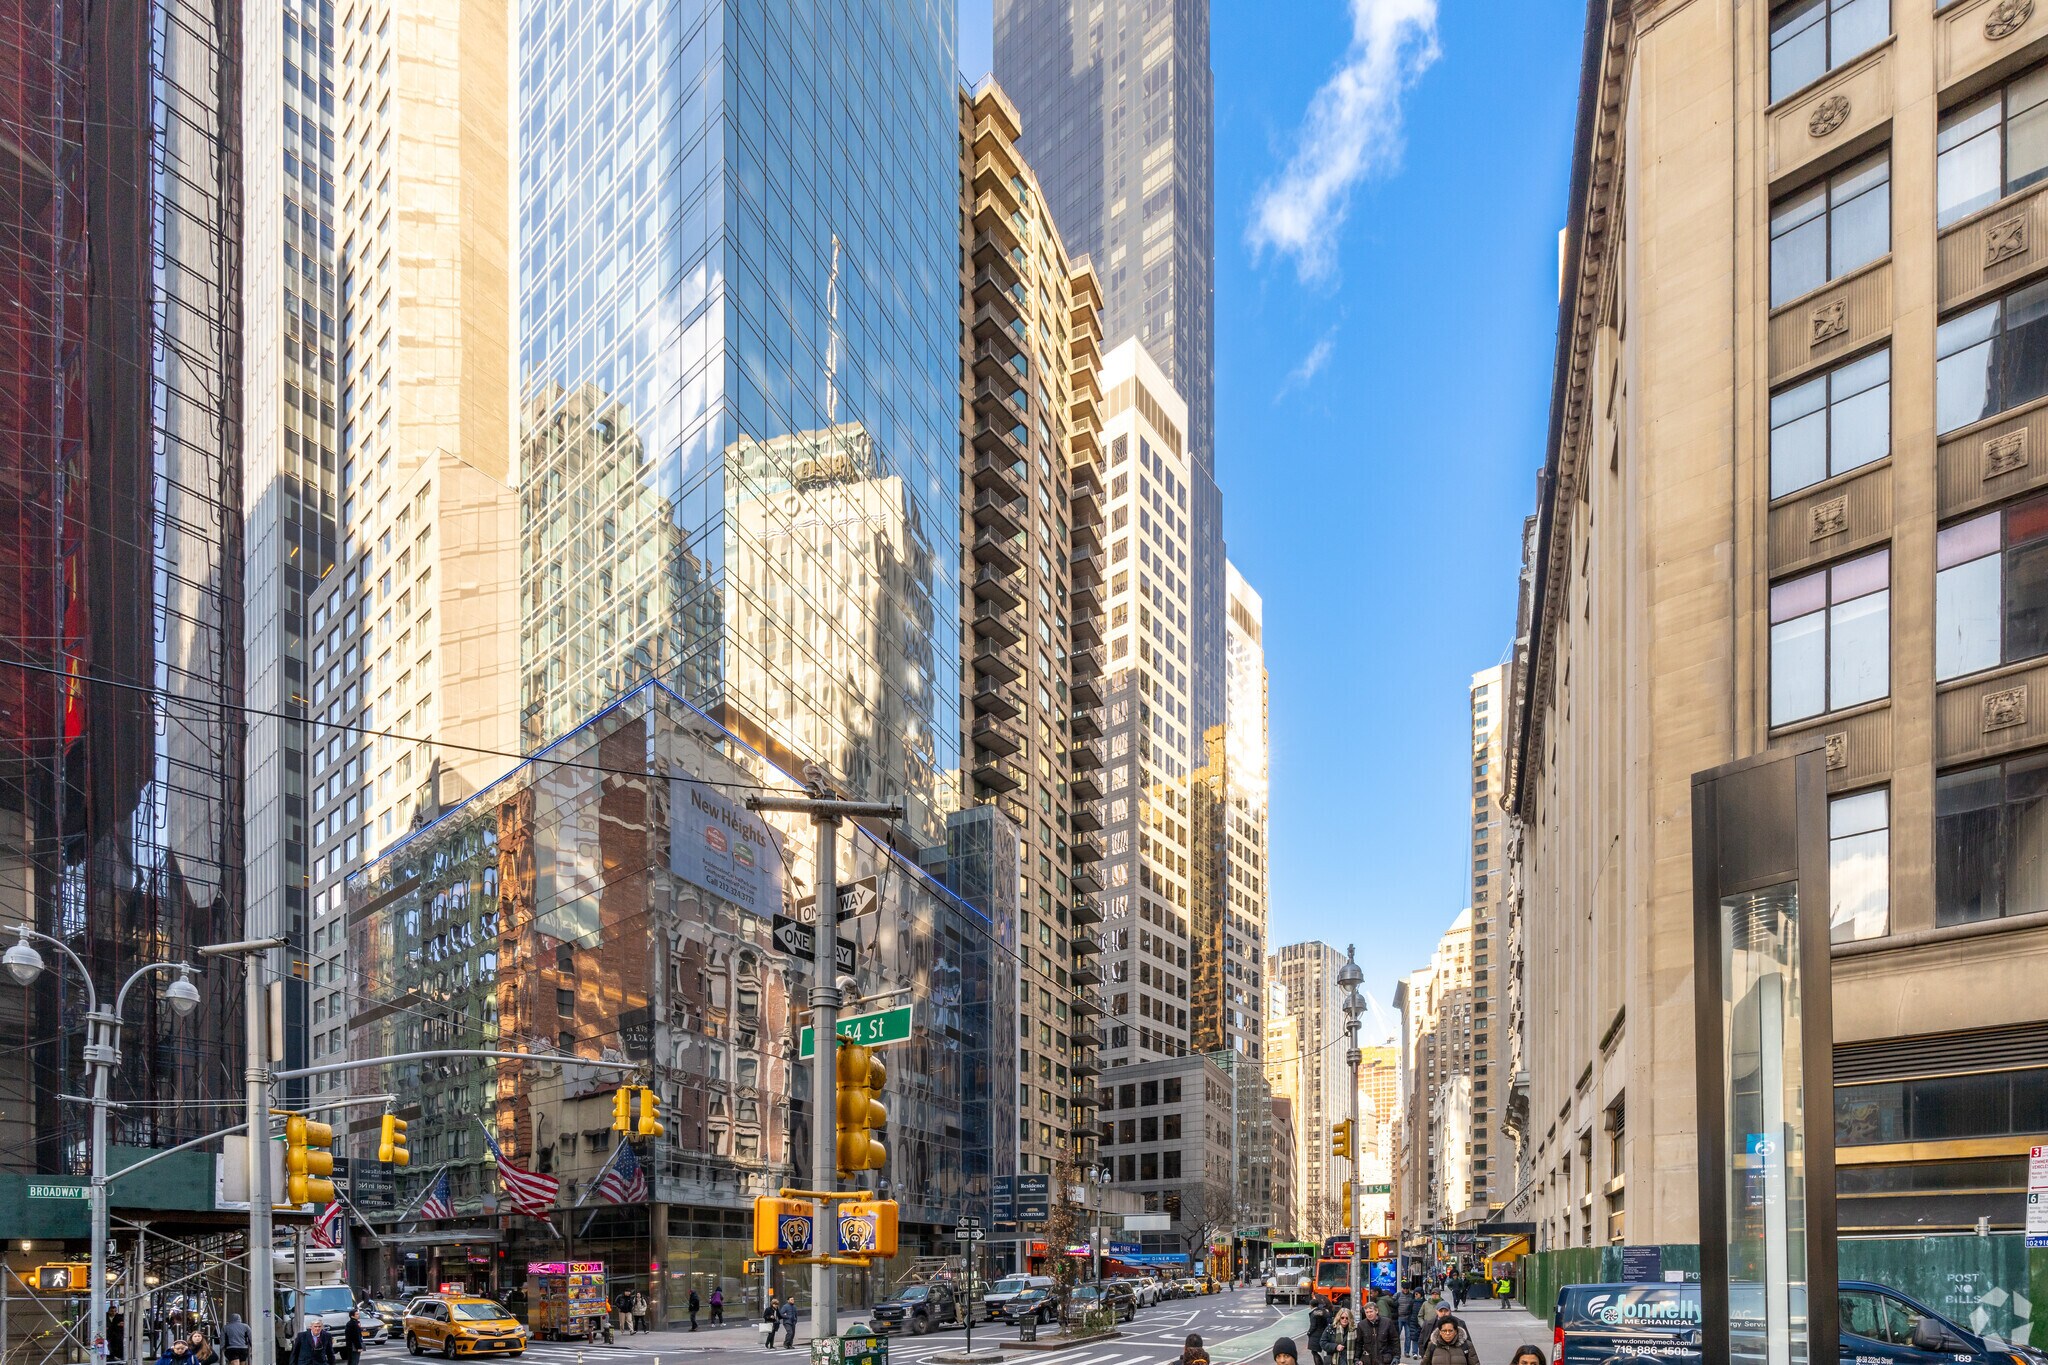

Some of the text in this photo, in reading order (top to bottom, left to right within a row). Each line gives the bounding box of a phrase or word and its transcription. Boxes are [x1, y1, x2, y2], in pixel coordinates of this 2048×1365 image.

[691, 788, 766, 848] New Heights
[706, 875, 754, 905] Call 212.324.3773
[804, 890, 866, 921] ON WAY
[784, 929, 849, 963] ONE AY
[845, 1018, 884, 1041] 54 St
[2033, 1148, 2040, 1157] 3
[30, 1187, 79, 1197] BROADWAY
[1375, 1185, 1382, 1193] 54
[2030, 1195, 2037, 1203] 6
[573, 1264, 599, 1273] SODA
[1685, 1272, 1701, 1280] PO
[1947, 1273, 1979, 1282] POST
[1955, 1284, 1973, 1293] NO
[1945, 1295, 1981, 1304] BILLS
[1600, 1294, 1702, 1325] donnelly
[1624, 1318, 1695, 1326] MECHANICAL
[1612, 1338, 1692, 1346] www.donnellymech.com
[1614, 1345, 1689, 1356] 718-886-1500
[1954, 1354, 1972, 1363] 169
